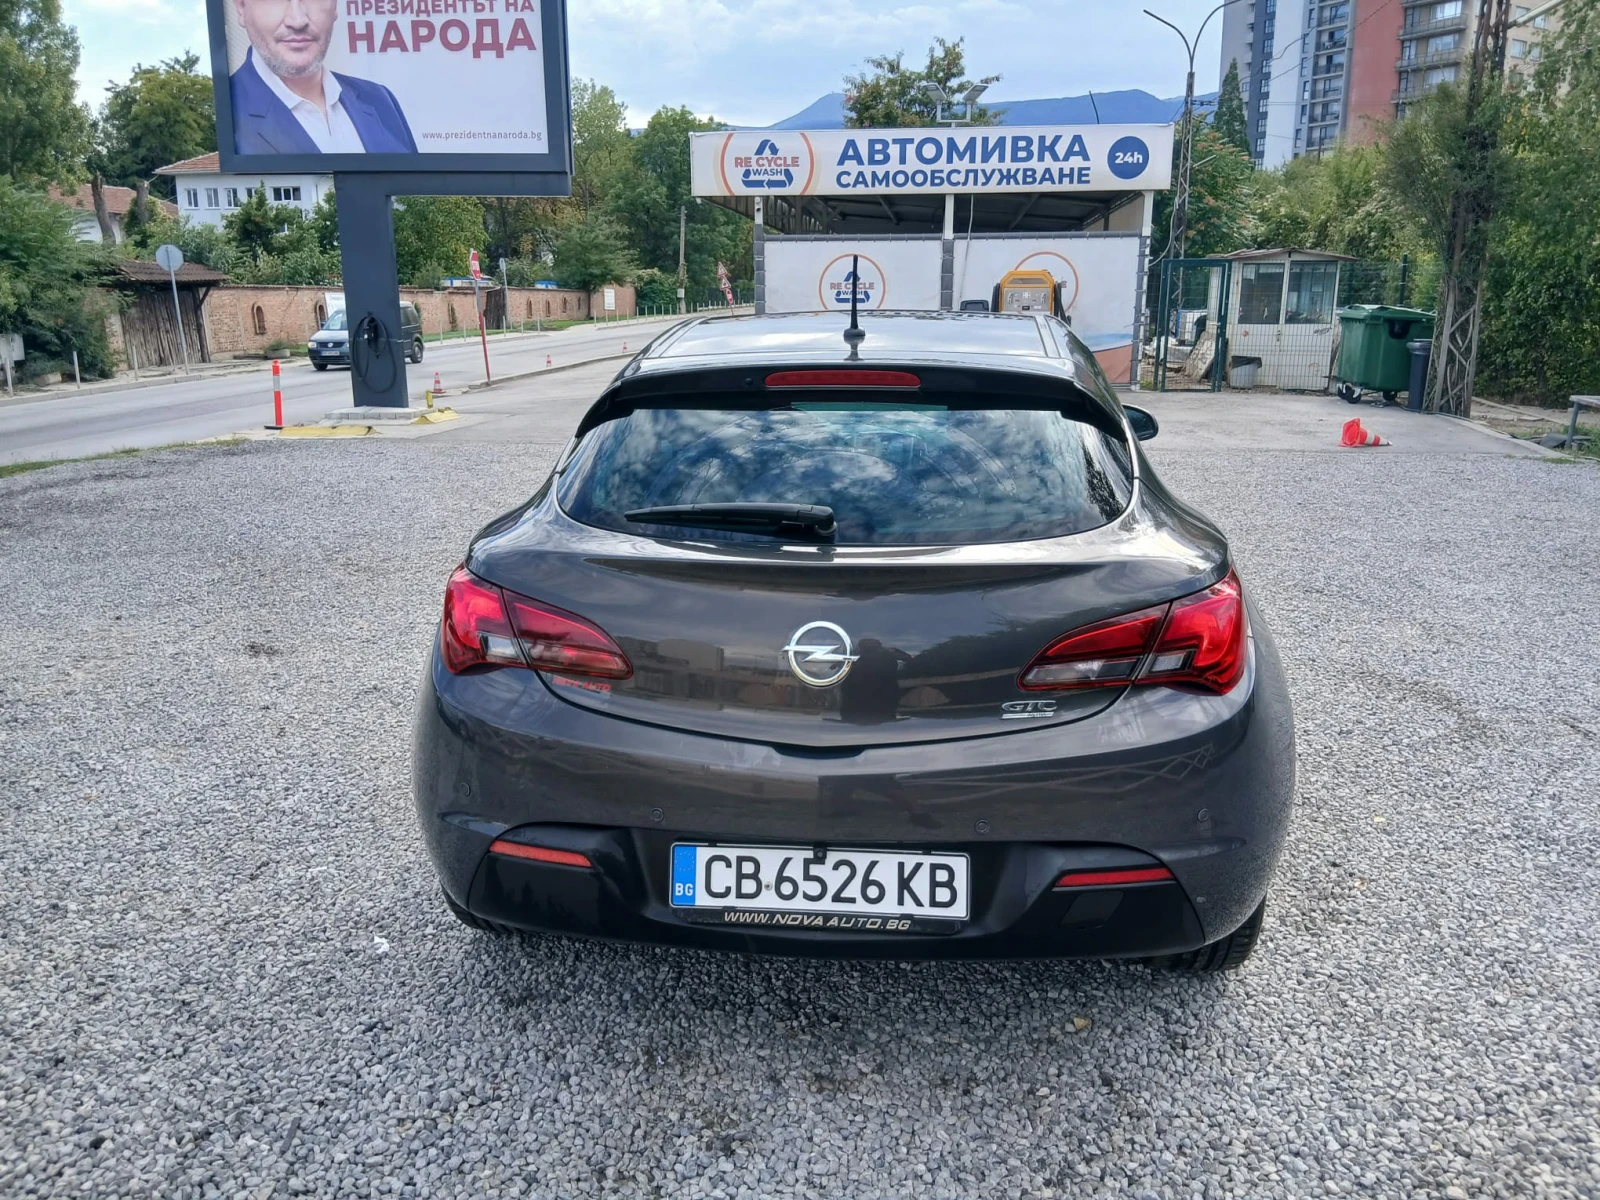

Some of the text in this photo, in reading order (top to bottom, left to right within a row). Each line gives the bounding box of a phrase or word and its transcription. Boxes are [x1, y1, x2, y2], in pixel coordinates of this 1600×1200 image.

[346, 0, 535, 17] ПРЕЗИДЕНТЪТ НА
[347, 17, 537, 59] НАРОДА
[421, 130, 542, 141] www.prezidentnanaroda.bg
[836, 134, 1091, 166] АВТОМИВКА
[734, 156, 800, 168] RE CYCLE
[1114, 151, 1143, 164] 24h
[751, 168, 783, 176] WASH
[836, 166, 1091, 189] САМООБСЛУЖВАНЕ
[830, 282, 842, 290] RE
[1001, 700, 1057, 711] GTC
[674, 854, 958, 908] BG CB 6526 KB
